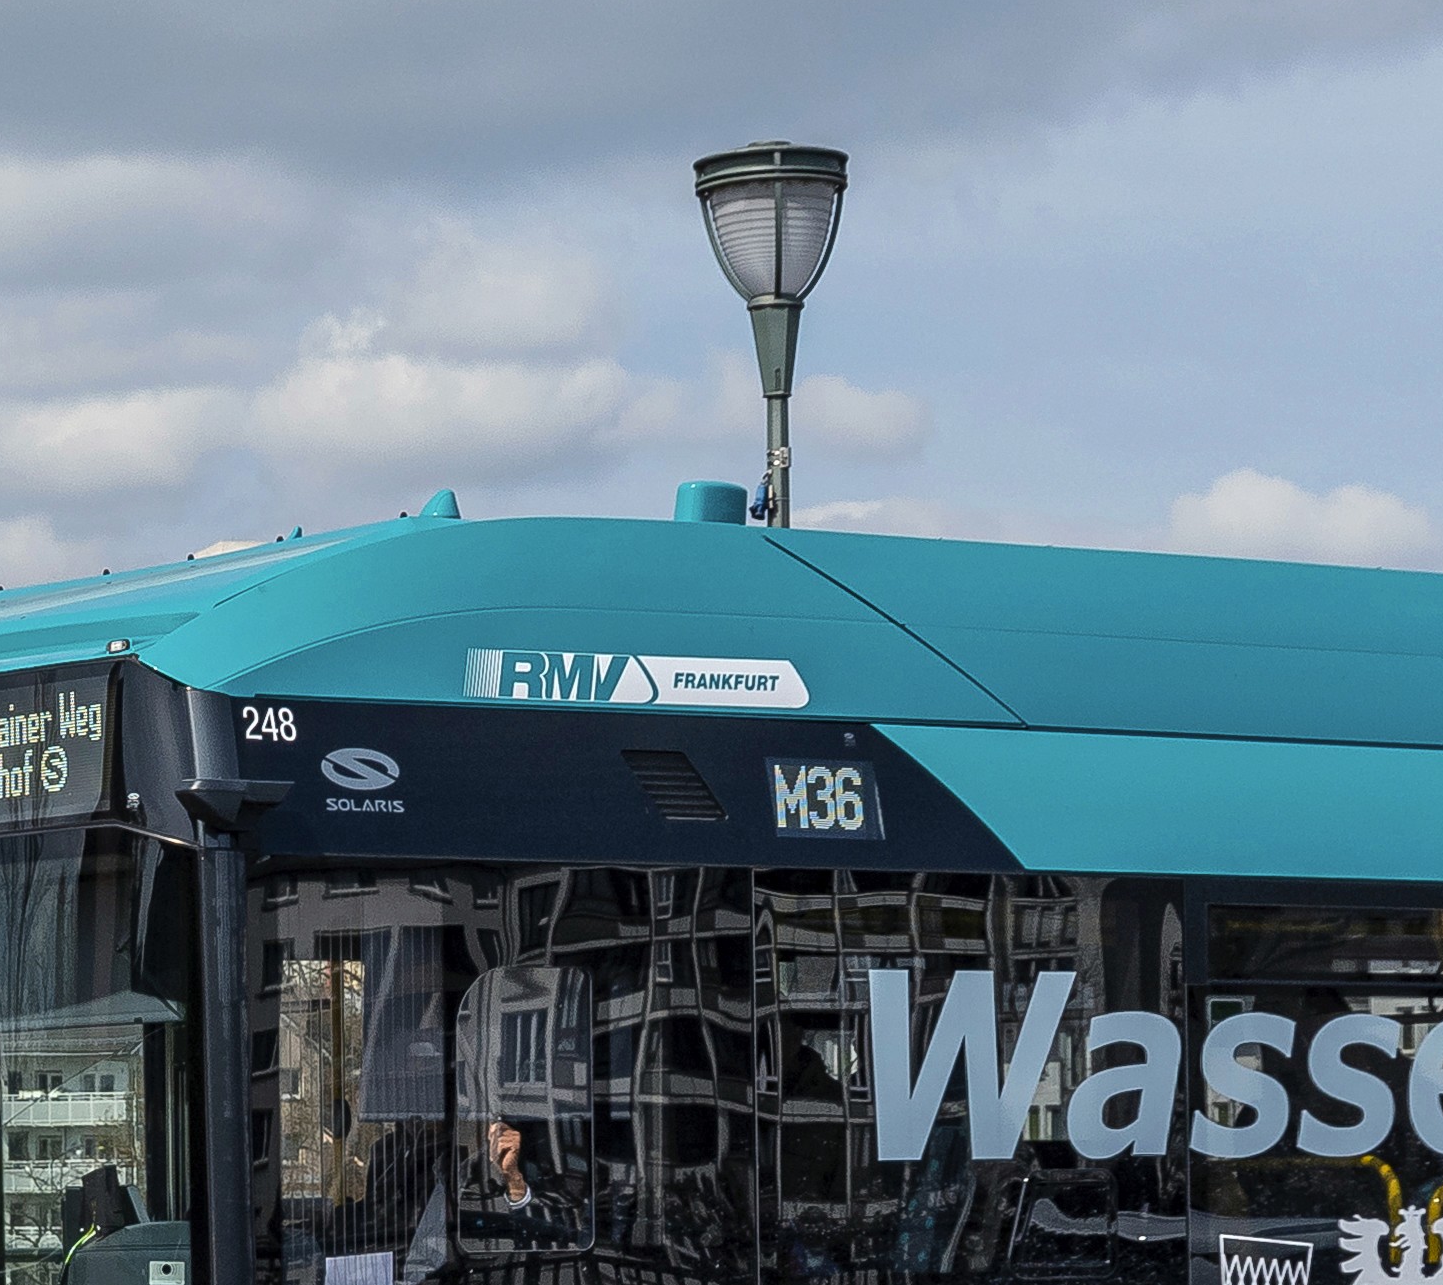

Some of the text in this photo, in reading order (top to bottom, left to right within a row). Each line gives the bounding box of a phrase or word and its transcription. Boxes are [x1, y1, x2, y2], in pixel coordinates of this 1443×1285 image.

[498, 649, 780, 702] RMV FRANKFURT
[57, 690, 103, 741] Weg
[242, 706, 297, 742] 248
[326, 797, 405, 813] SOLARIS
[772, 763, 865, 831] M36
